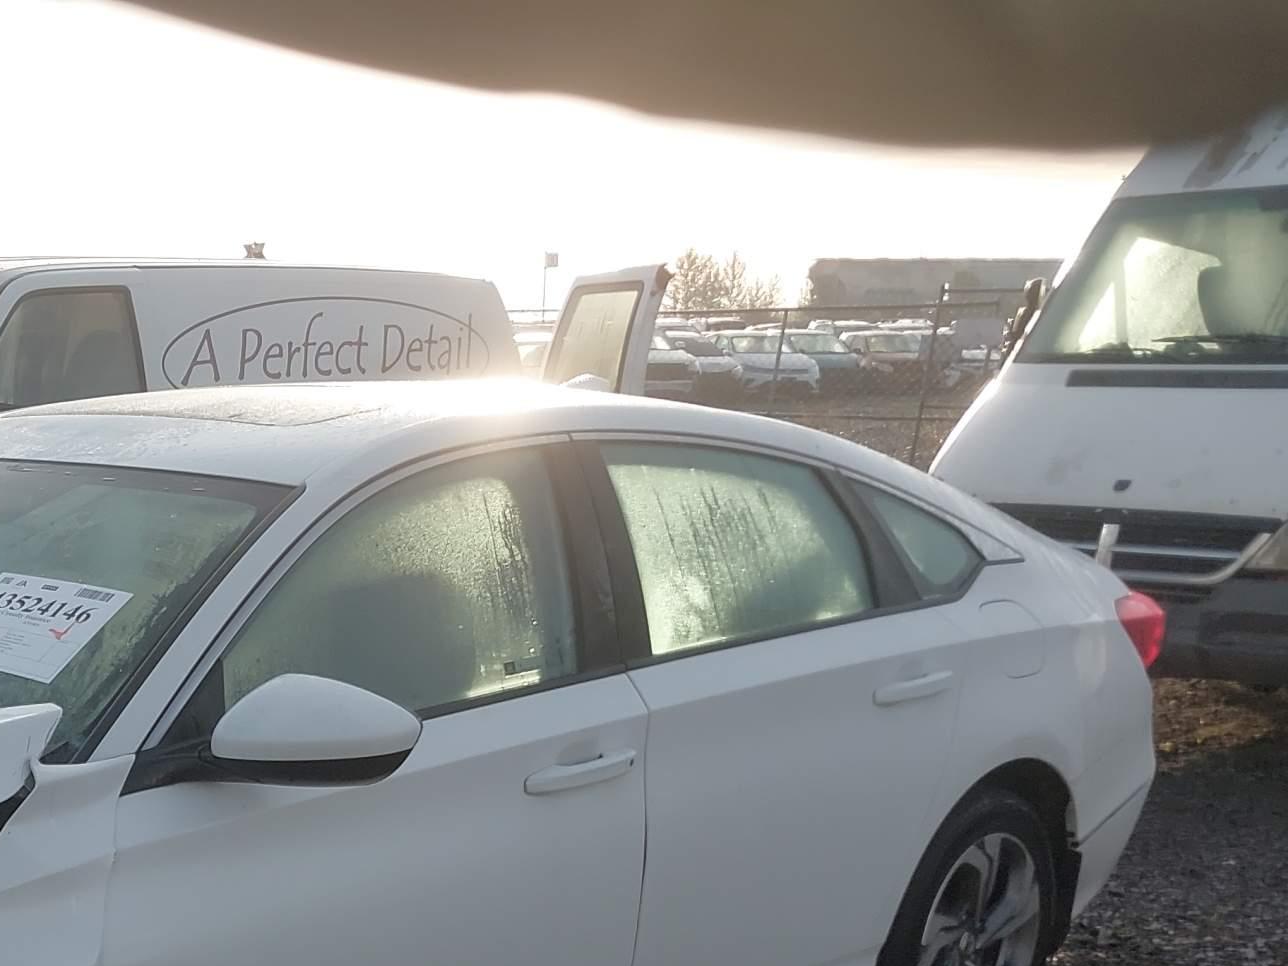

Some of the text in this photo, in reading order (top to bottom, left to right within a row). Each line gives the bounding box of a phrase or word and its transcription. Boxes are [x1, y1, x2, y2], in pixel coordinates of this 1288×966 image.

[181, 311, 473, 387] A Perfect Detail
